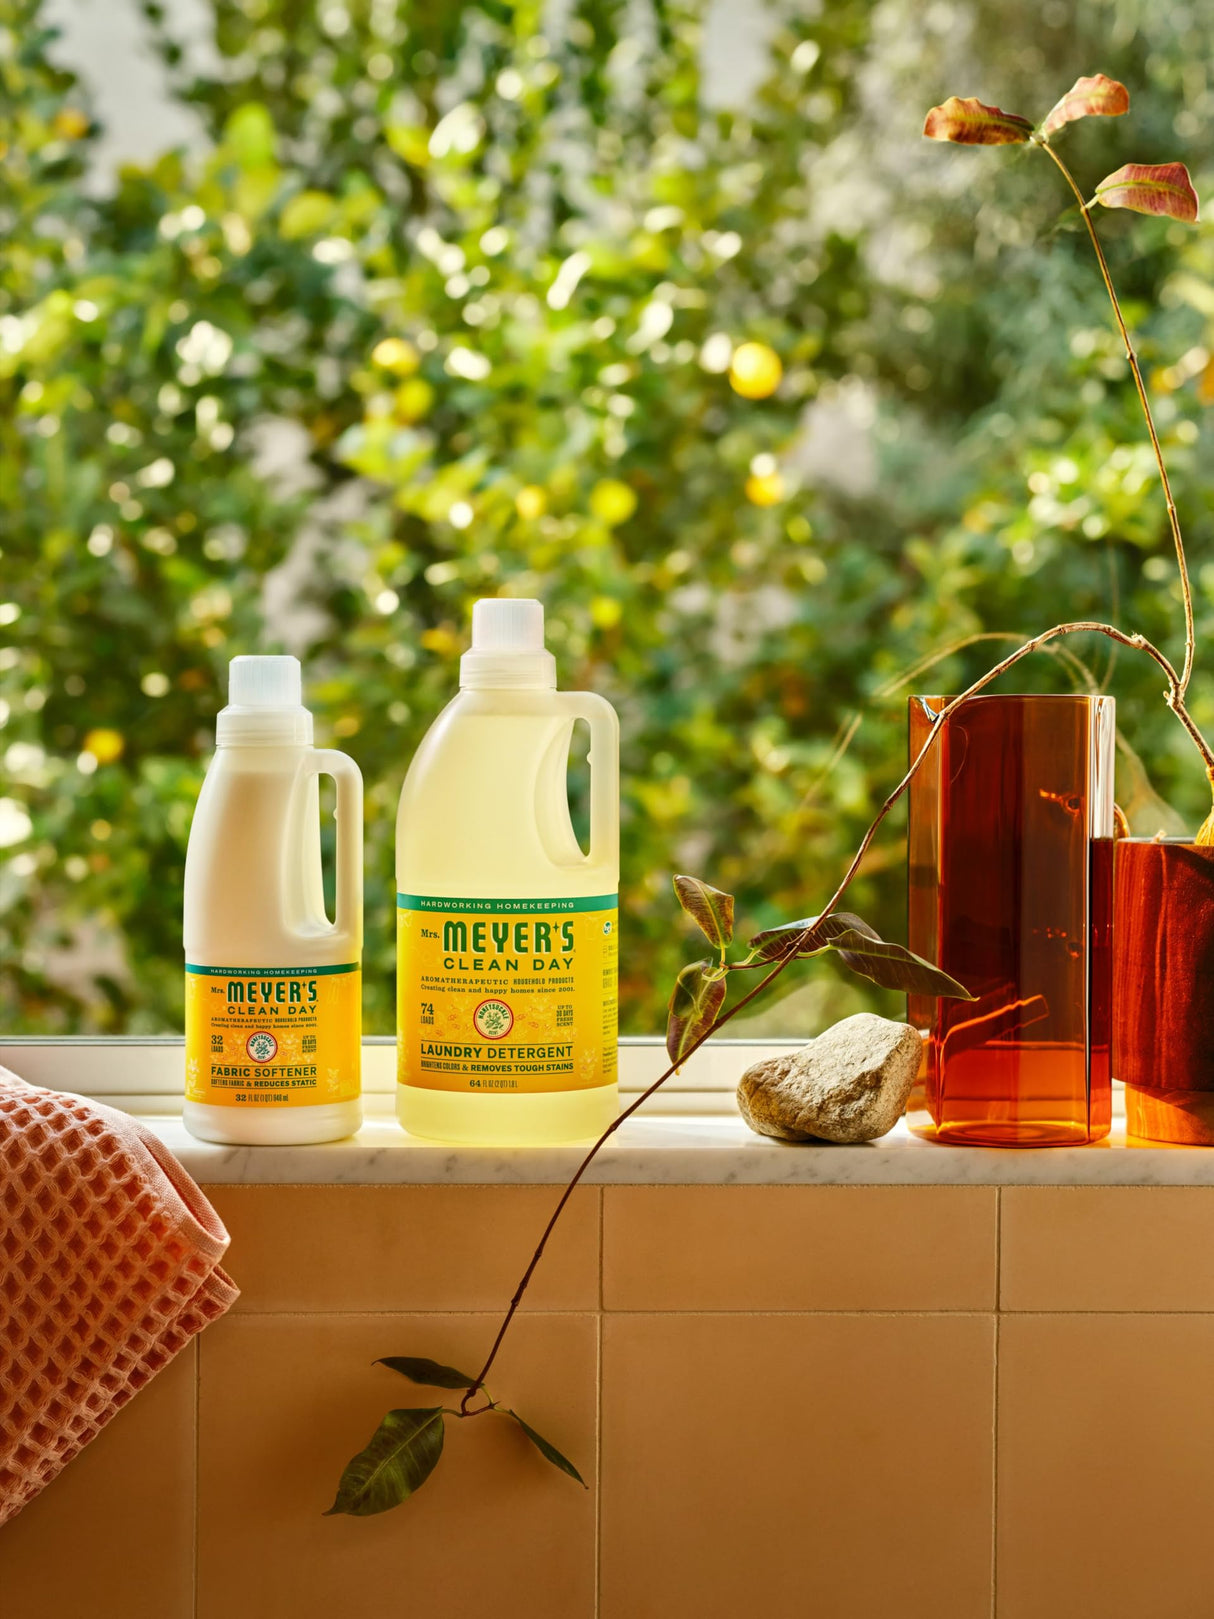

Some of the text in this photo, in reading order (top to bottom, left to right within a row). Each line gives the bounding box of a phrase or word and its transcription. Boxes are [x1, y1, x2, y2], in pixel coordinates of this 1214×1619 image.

[421, 900, 491, 909] HARDWORKING
[421, 920, 574, 954] Mrs. MEYER'S
[444, 958, 574, 971] CLEAN DAY
[421, 976, 508, 985] AROMATHERAPEUTIC
[548, 976, 574, 984] PRODUCTS
[227, 981, 317, 1004] MEYER'S
[421, 984, 446, 992] Creating
[228, 1005, 316, 1015] CLEAN DAY
[421, 1002, 434, 1015] 74
[478, 1004, 509, 1019] HONEYSUCKLE
[421, 1016, 434, 1024] LOADS
[211, 1035, 223, 1045] 32
[421, 1044, 573, 1058] LAUNDRY DETERGENT
[421, 1060, 442, 1070] BRIGHTENS
[443, 1062, 460, 1070] COLORS
[546, 1062, 574, 1070] STAINS
[211, 1066, 316, 1077] FABRIC SOFTENER
